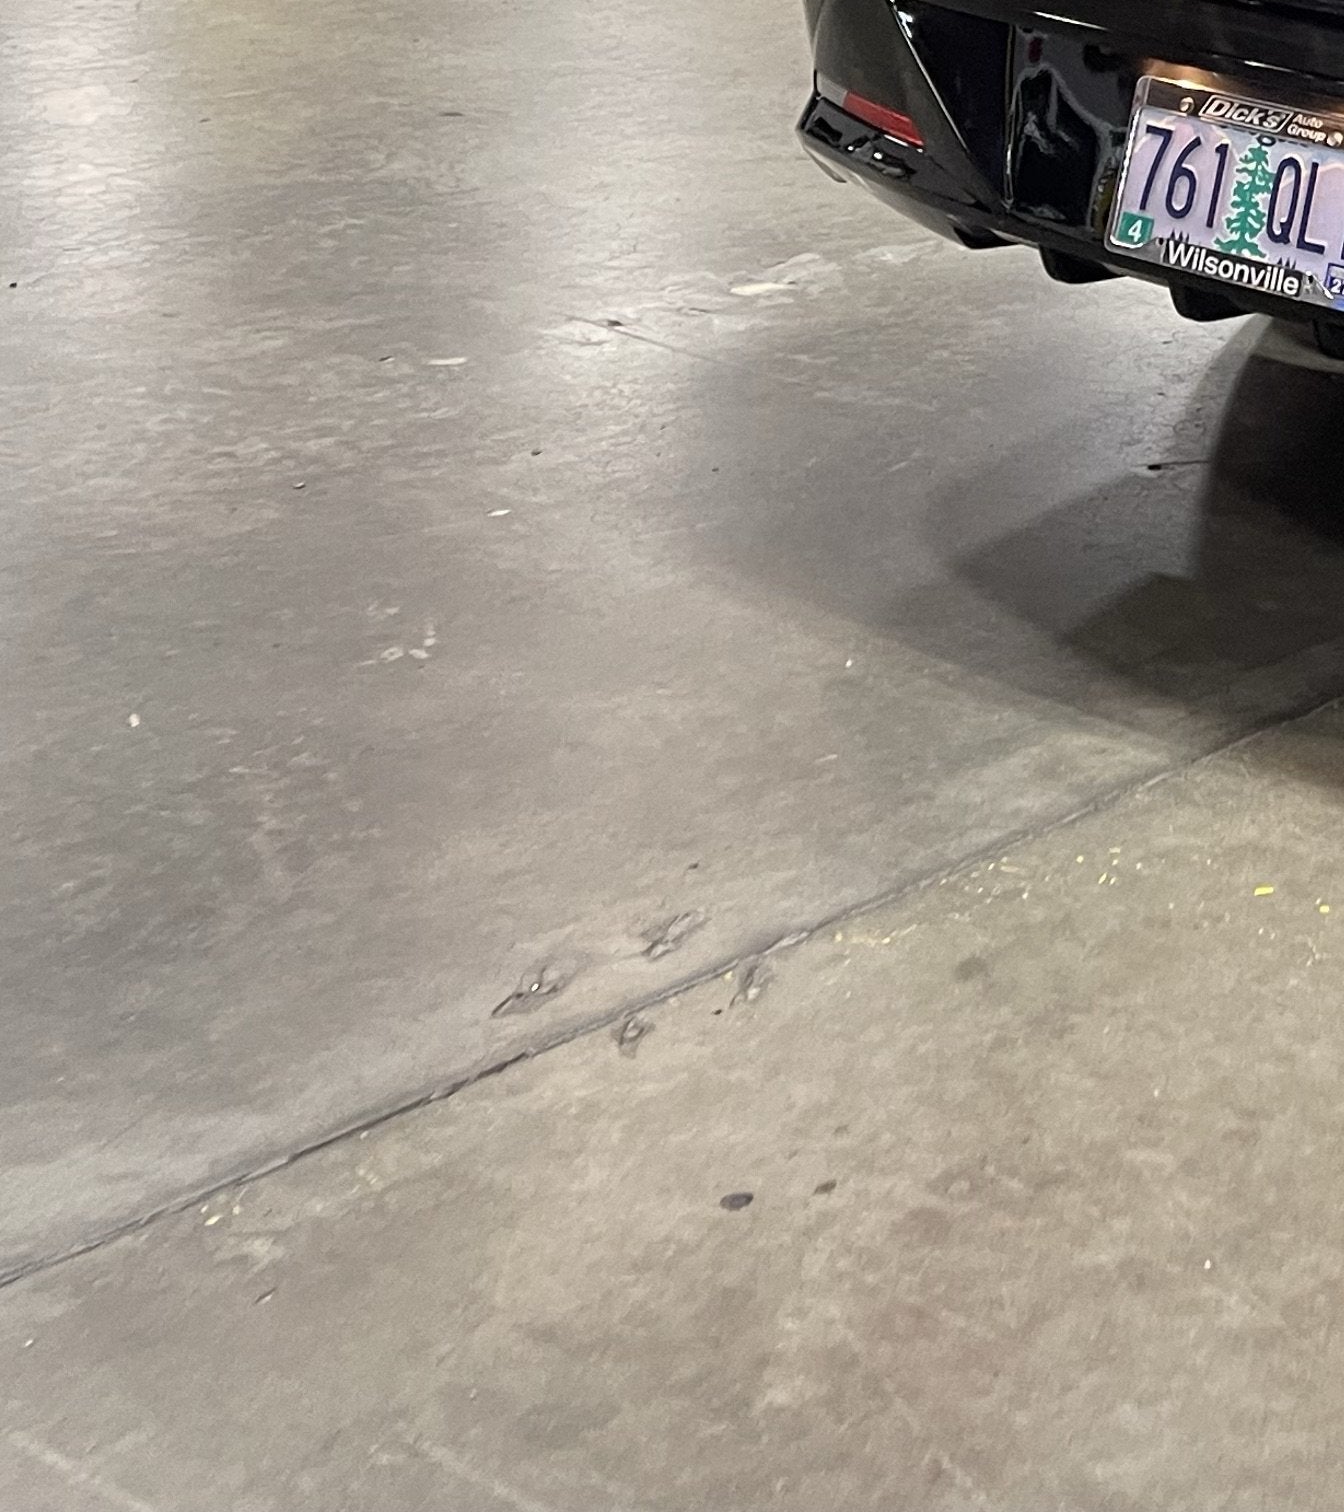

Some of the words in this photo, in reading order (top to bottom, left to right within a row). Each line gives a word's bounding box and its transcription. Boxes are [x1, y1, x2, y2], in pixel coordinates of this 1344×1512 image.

[1203, 98, 1287, 130] Dick's
[1293, 114, 1324, 129] Auto
[1287, 125, 1327, 143] Group
[1139, 123, 1229, 229] 761
[1127, 219, 1142, 241] 4
[1167, 239, 1300, 296] Wilsonville
